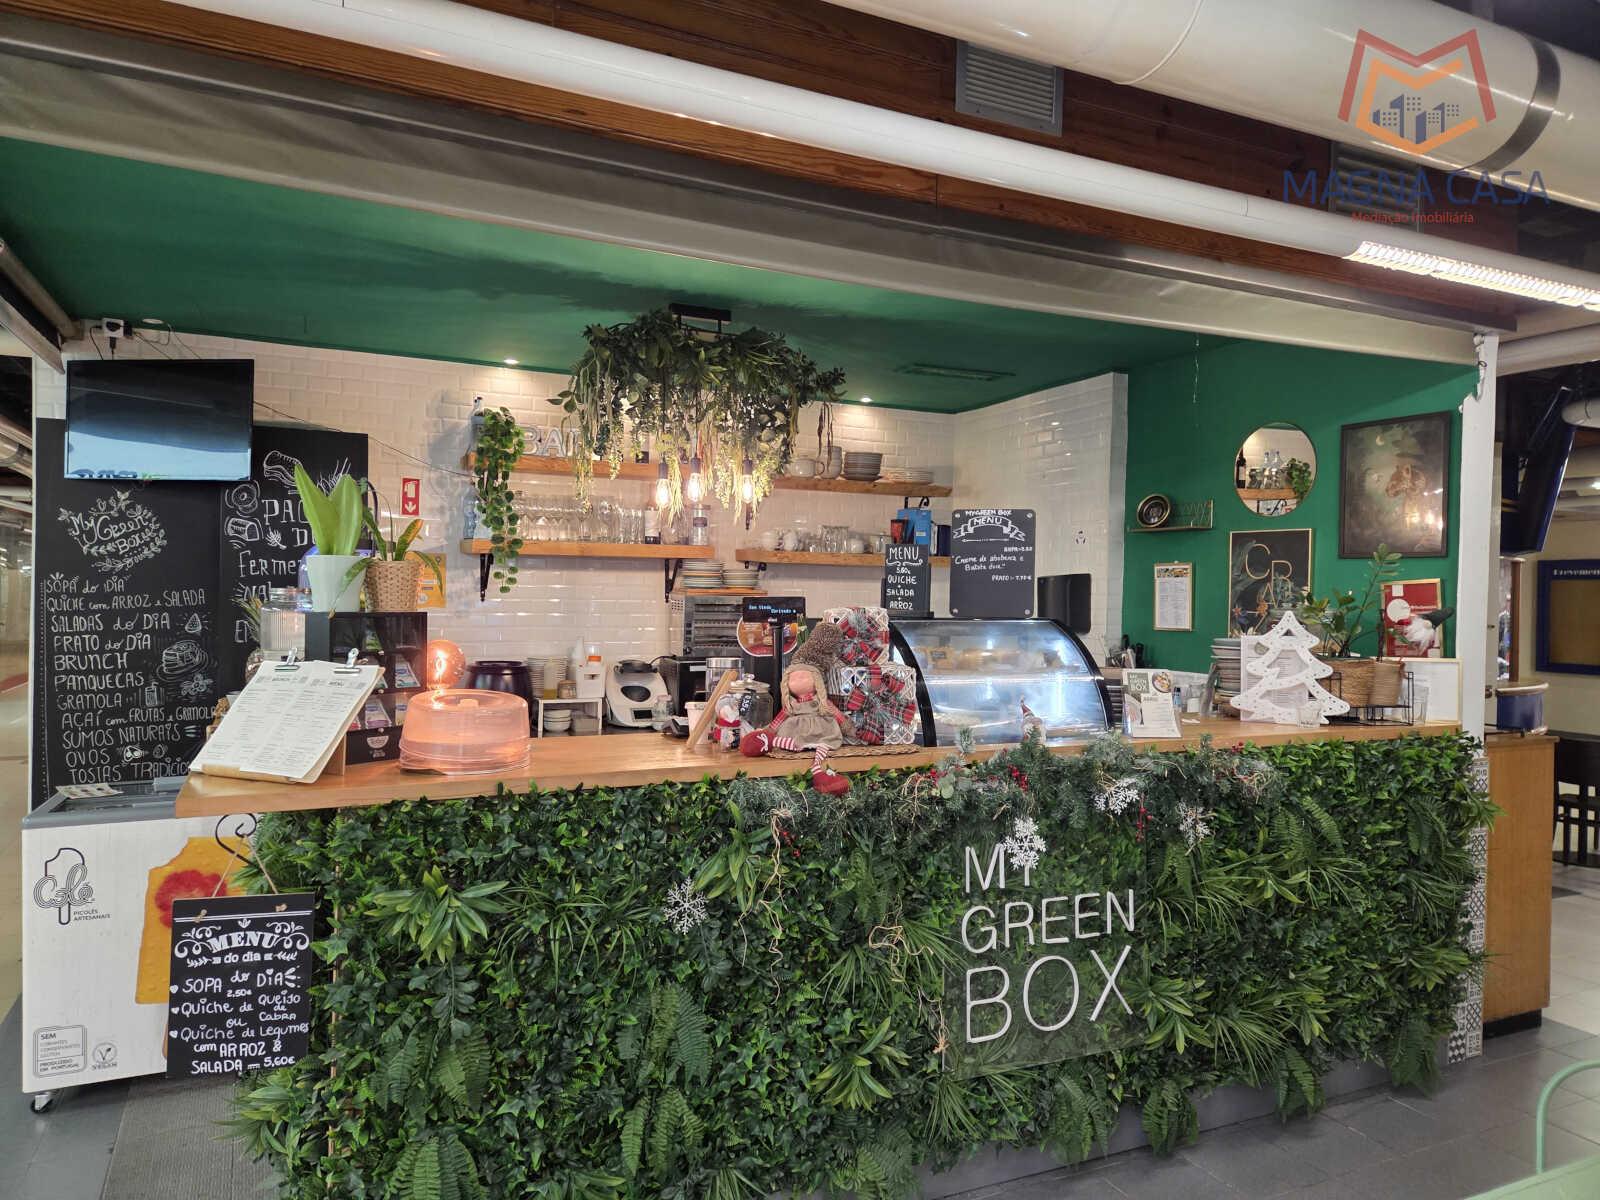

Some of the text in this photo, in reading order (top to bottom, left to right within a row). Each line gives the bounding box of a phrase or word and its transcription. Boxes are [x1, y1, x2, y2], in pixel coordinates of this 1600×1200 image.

[973, 516, 1003, 526] MENU
[889, 546, 920, 561] MENU
[47, 579, 78, 594] SOPA
[887, 574, 918, 585] QUICHE
[111, 594, 151, 610] ARROZ
[163, 588, 206, 608] SALADA
[886, 588, 915, 597] SALADA
[51, 613, 104, 633] SALADAS
[128, 706, 166, 723] FRUTAS
[65, 749, 111, 768] OVOS
[960, 888, 1136, 954] GREEN
[207, 930, 279, 954] MENU
[224, 951, 262, 964] do dia
[182, 977, 223, 994] SOPA
[964, 944, 1134, 1045] BOX
[239, 1001, 254, 1013] de
[273, 1003, 287, 1012] de
[241, 1027, 256, 1038] de
[193, 1042, 218, 1053] com
[219, 1041, 267, 1058] ARROZ
[190, 1059, 243, 1075] SALADA
